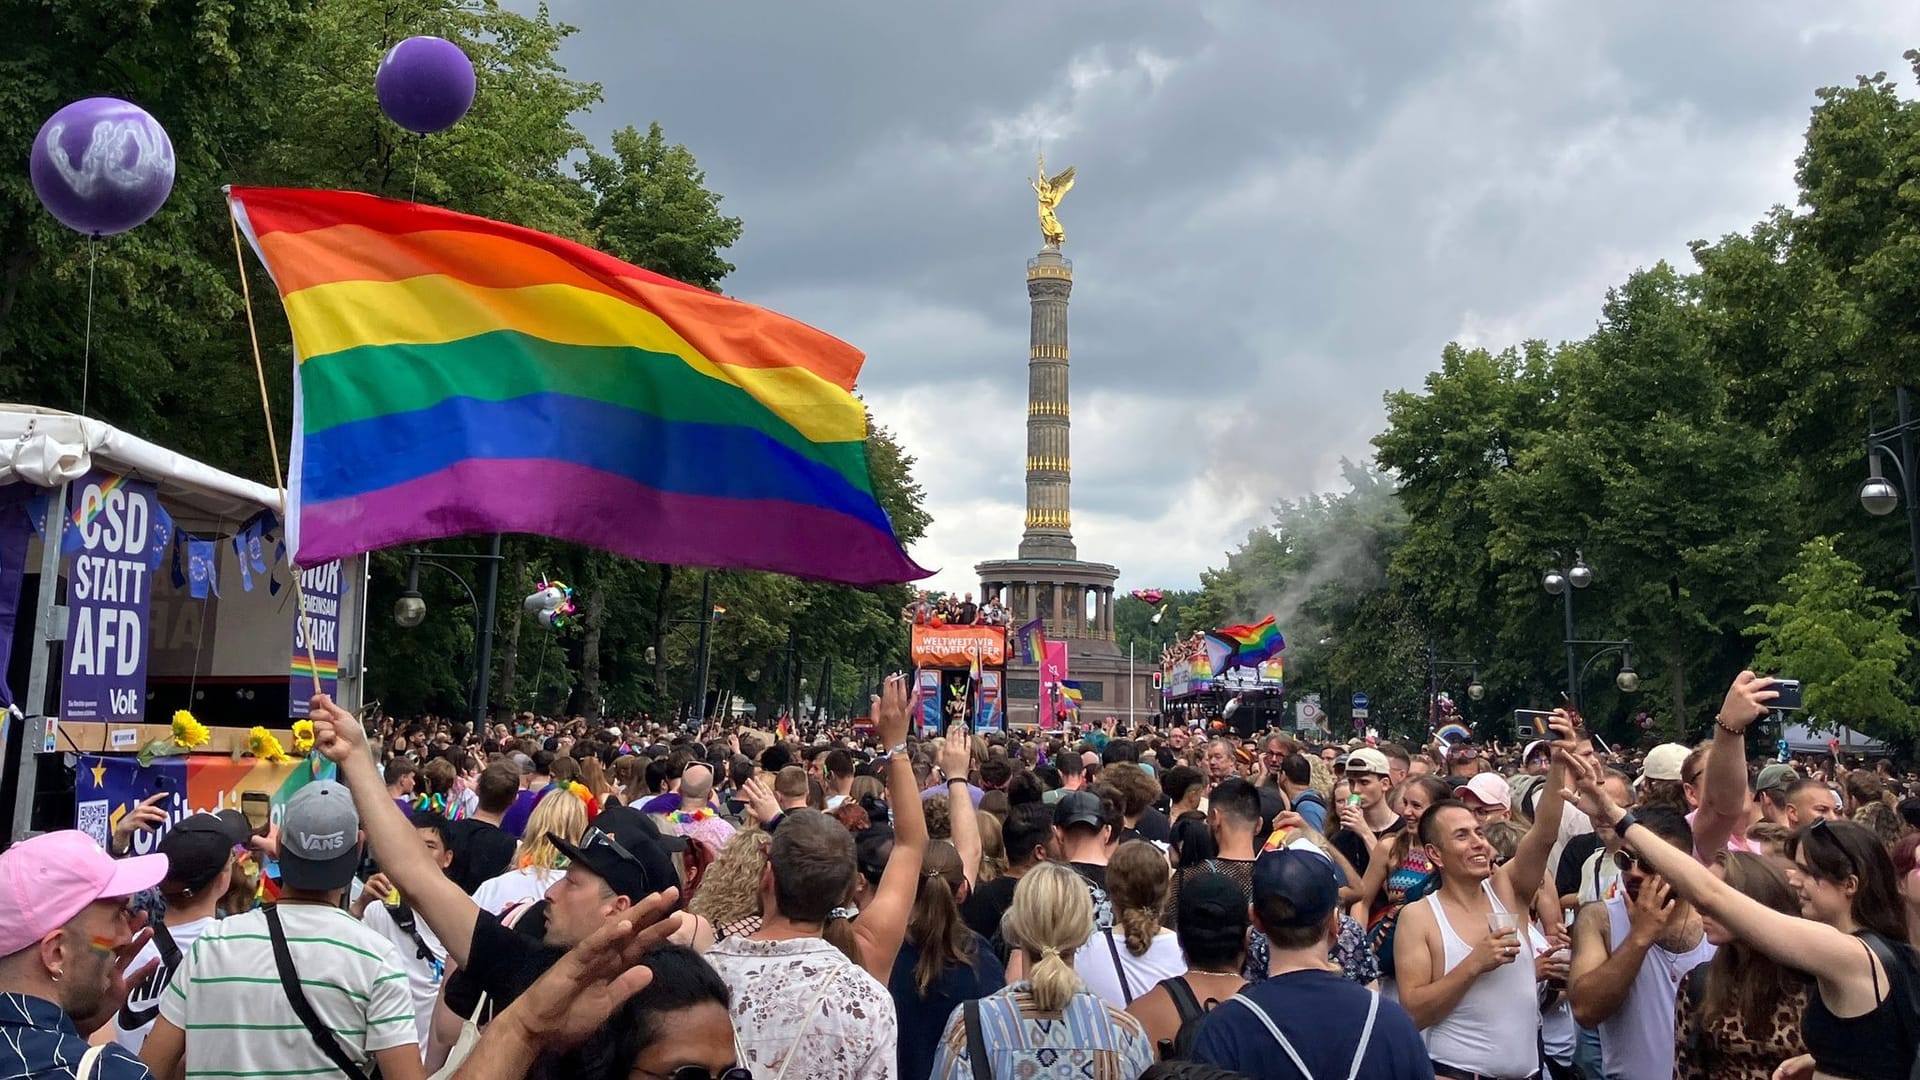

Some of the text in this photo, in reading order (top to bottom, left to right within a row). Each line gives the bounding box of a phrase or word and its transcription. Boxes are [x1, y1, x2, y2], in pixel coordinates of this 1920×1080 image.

[79, 483, 149, 555] CSD
[75, 554, 146, 604] STATT
[299, 594, 337, 617] EMEINSAM
[69, 606, 141, 676] AFD
[915, 645, 965, 656] WELTWEIT
[922, 636, 972, 646] WELTWEIT
[109, 689, 138, 715] Volt
[300, 830, 346, 851] VANS
